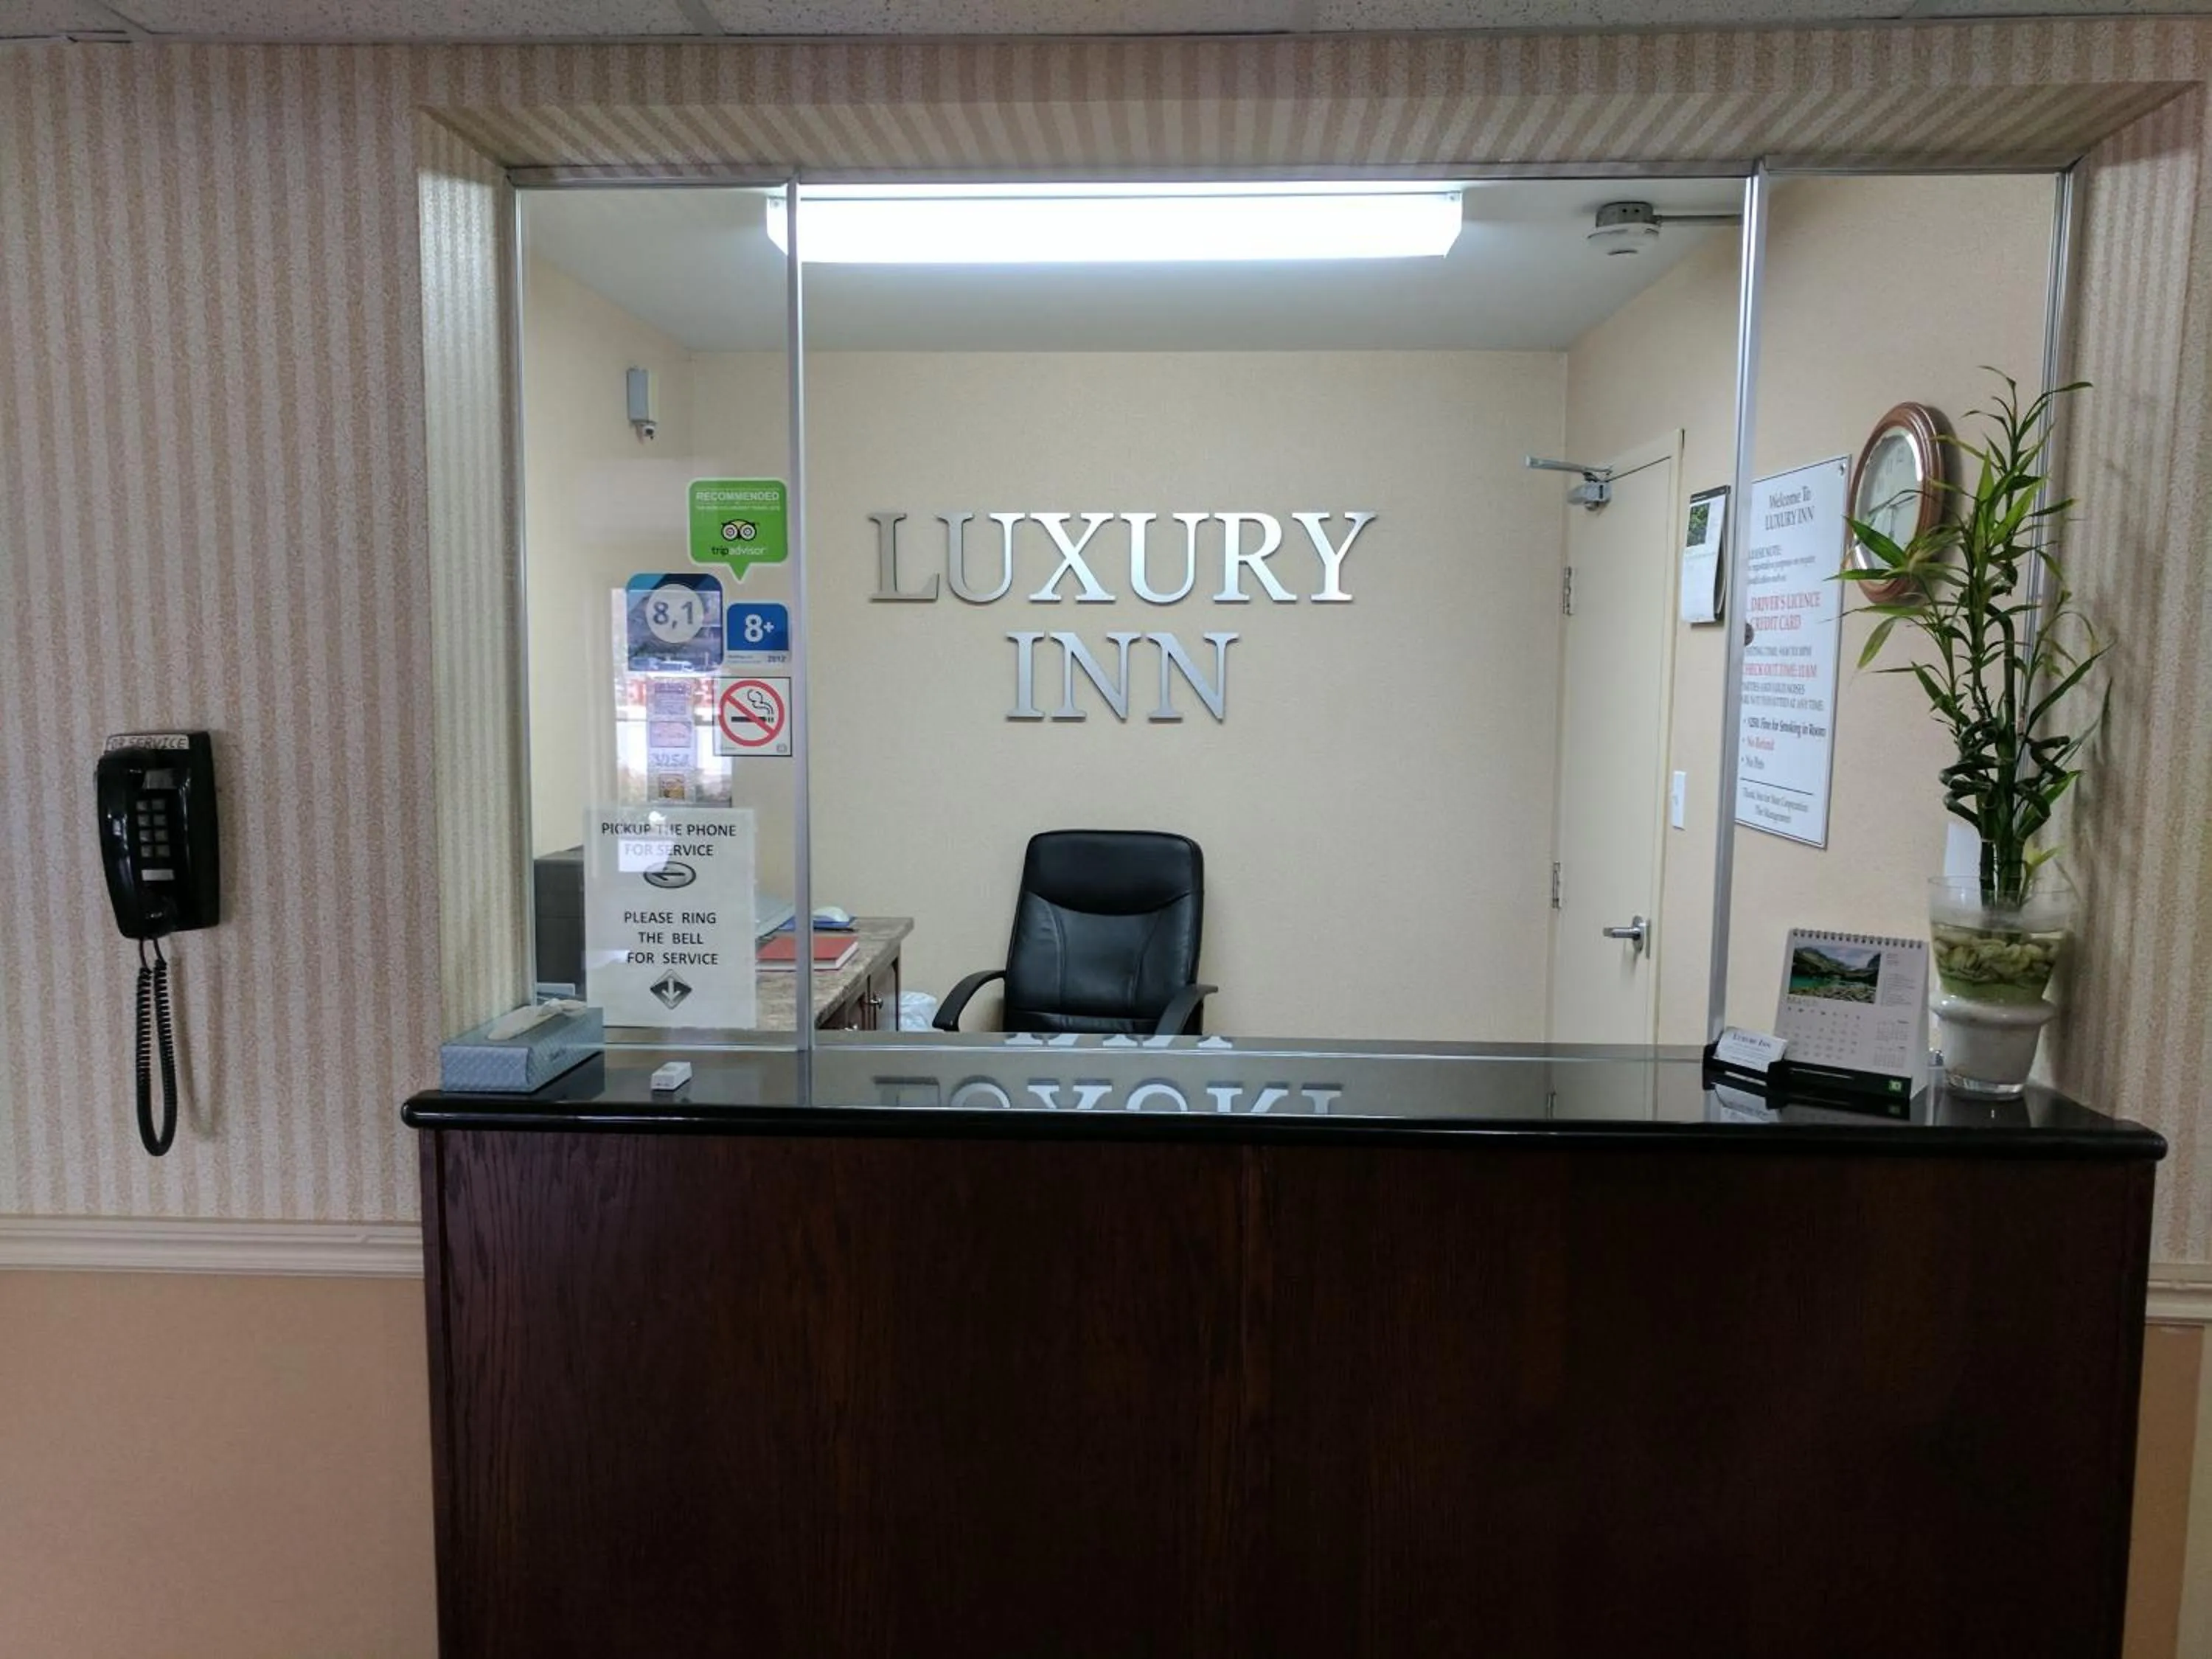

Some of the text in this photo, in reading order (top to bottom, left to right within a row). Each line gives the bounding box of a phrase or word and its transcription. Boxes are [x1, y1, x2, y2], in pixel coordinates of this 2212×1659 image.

[696, 491, 779, 501] RECOMMENDED
[1765, 509, 1797, 531] LUXURY
[711, 545, 766, 557] tripadvisor
[869, 512, 1377, 604] LUXURY
[653, 601, 694, 629] 8,1
[1006, 631, 1239, 721] INN
[601, 821, 651, 835] PICKUP
[687, 824, 737, 837] PHONE
[625, 844, 714, 856] FOR SERVICE
[625, 911, 717, 925] PLEASE RING
[638, 931, 703, 945] THE BELL
[627, 952, 719, 965] FOR SERVICE
